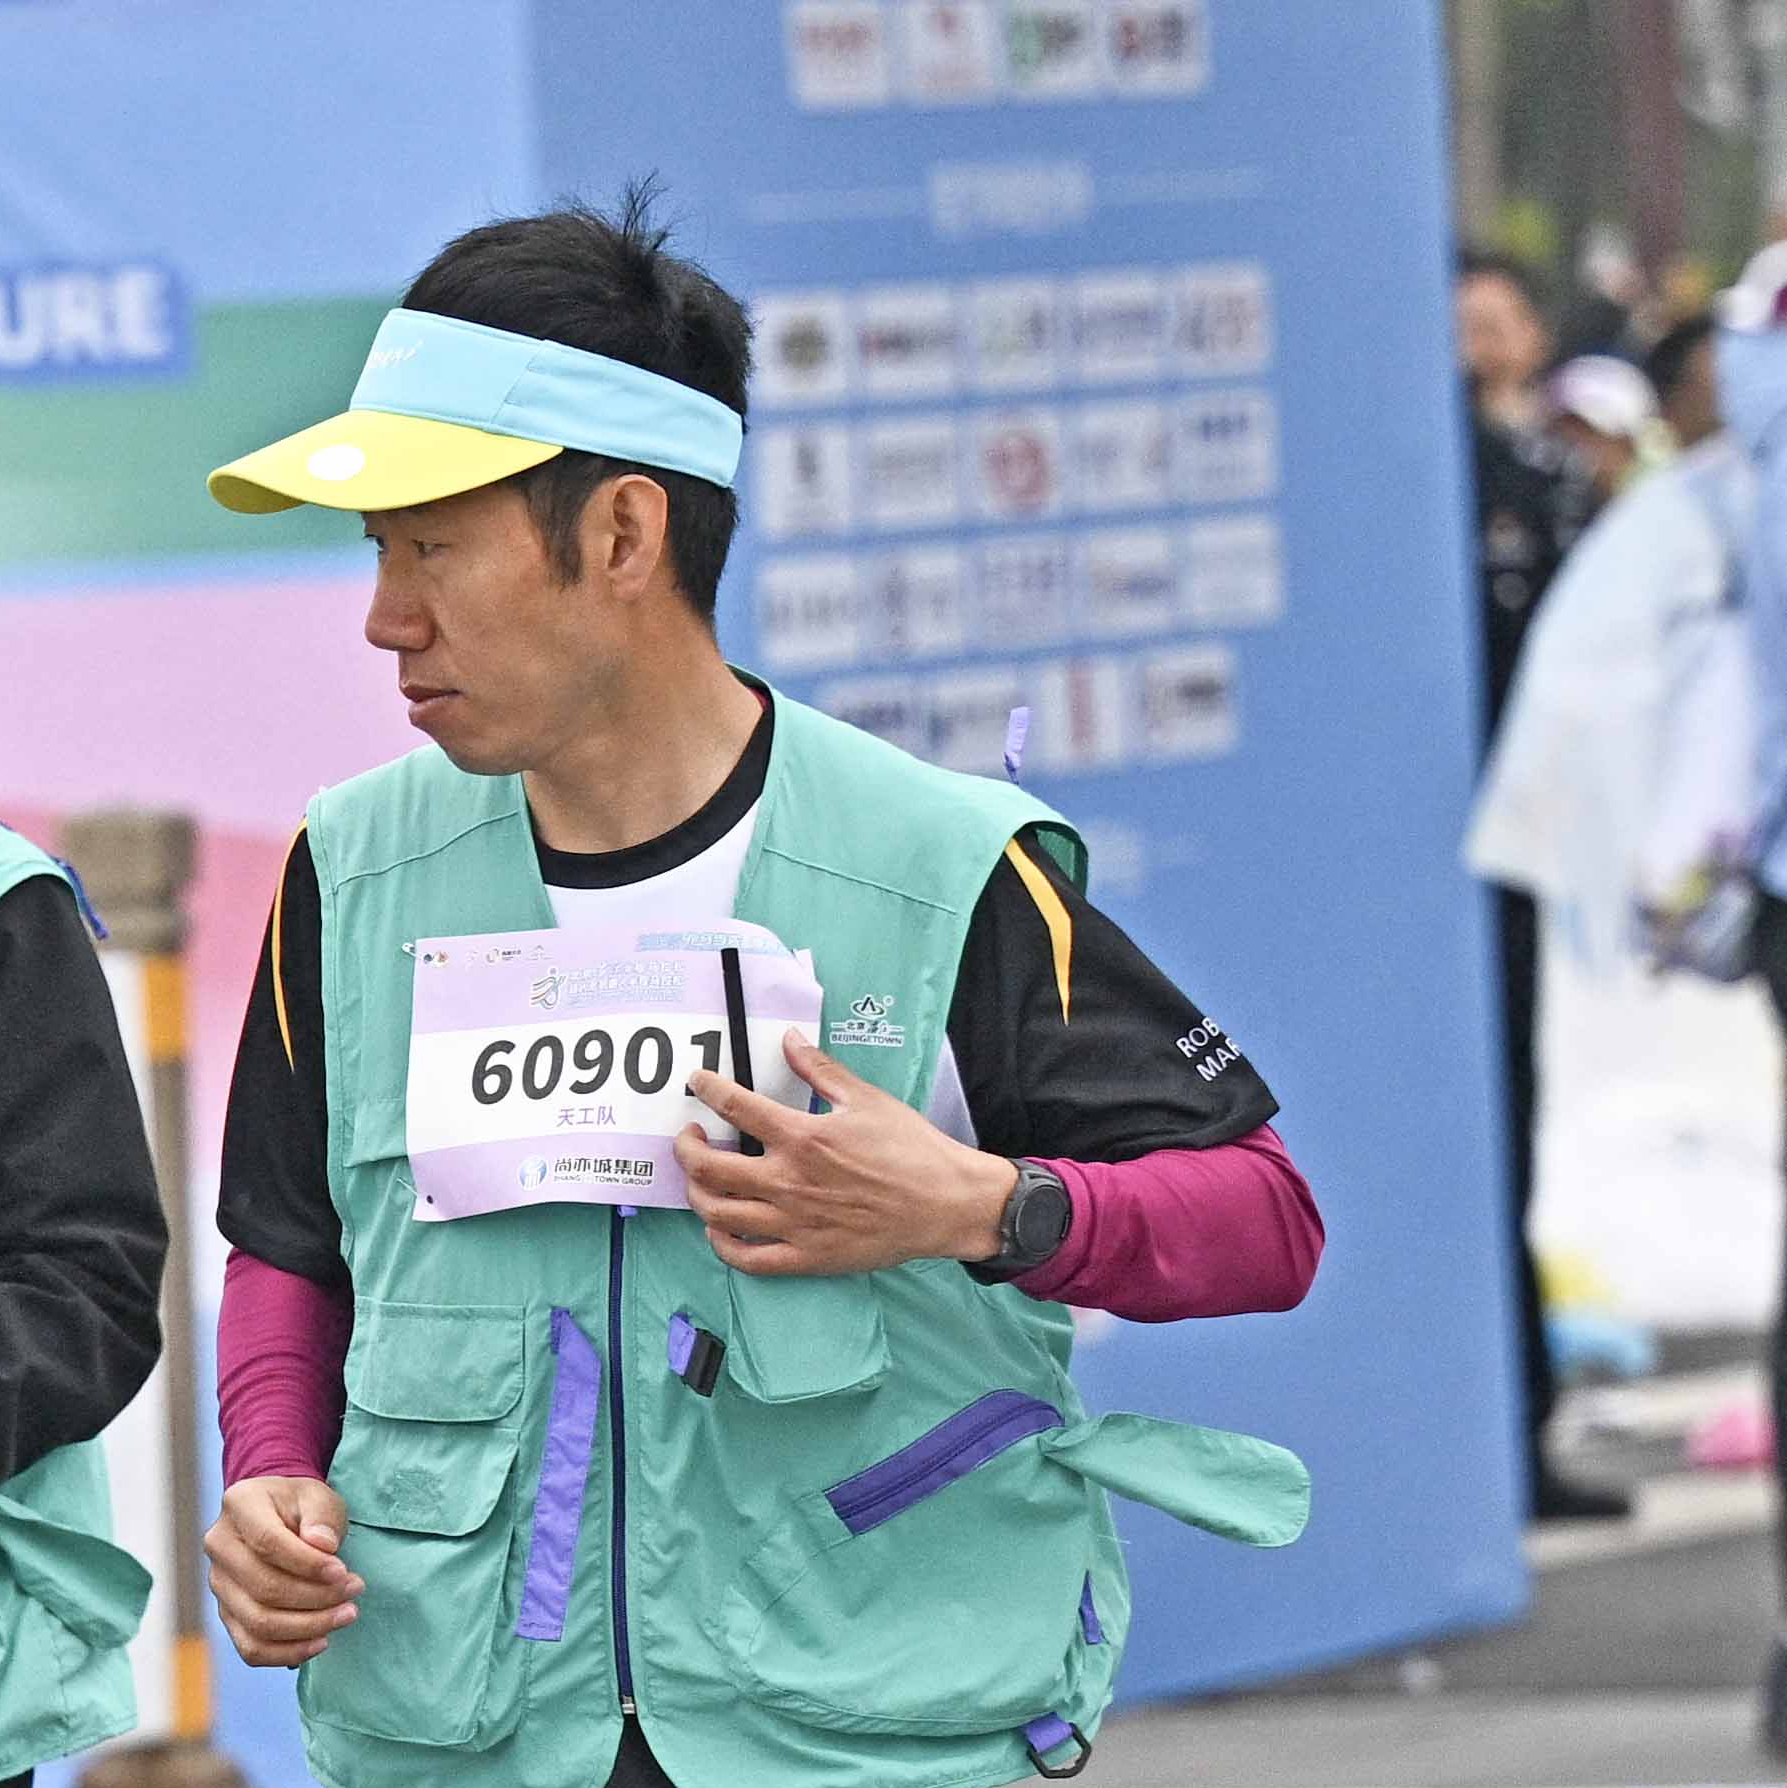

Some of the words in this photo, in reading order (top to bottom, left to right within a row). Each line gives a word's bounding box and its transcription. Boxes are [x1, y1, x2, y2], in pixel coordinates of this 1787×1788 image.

[471, 1026, 722, 1105] 60901
[556, 1105, 616, 1127] 天工队
[554, 1158, 654, 1177] 尚亦城集团
